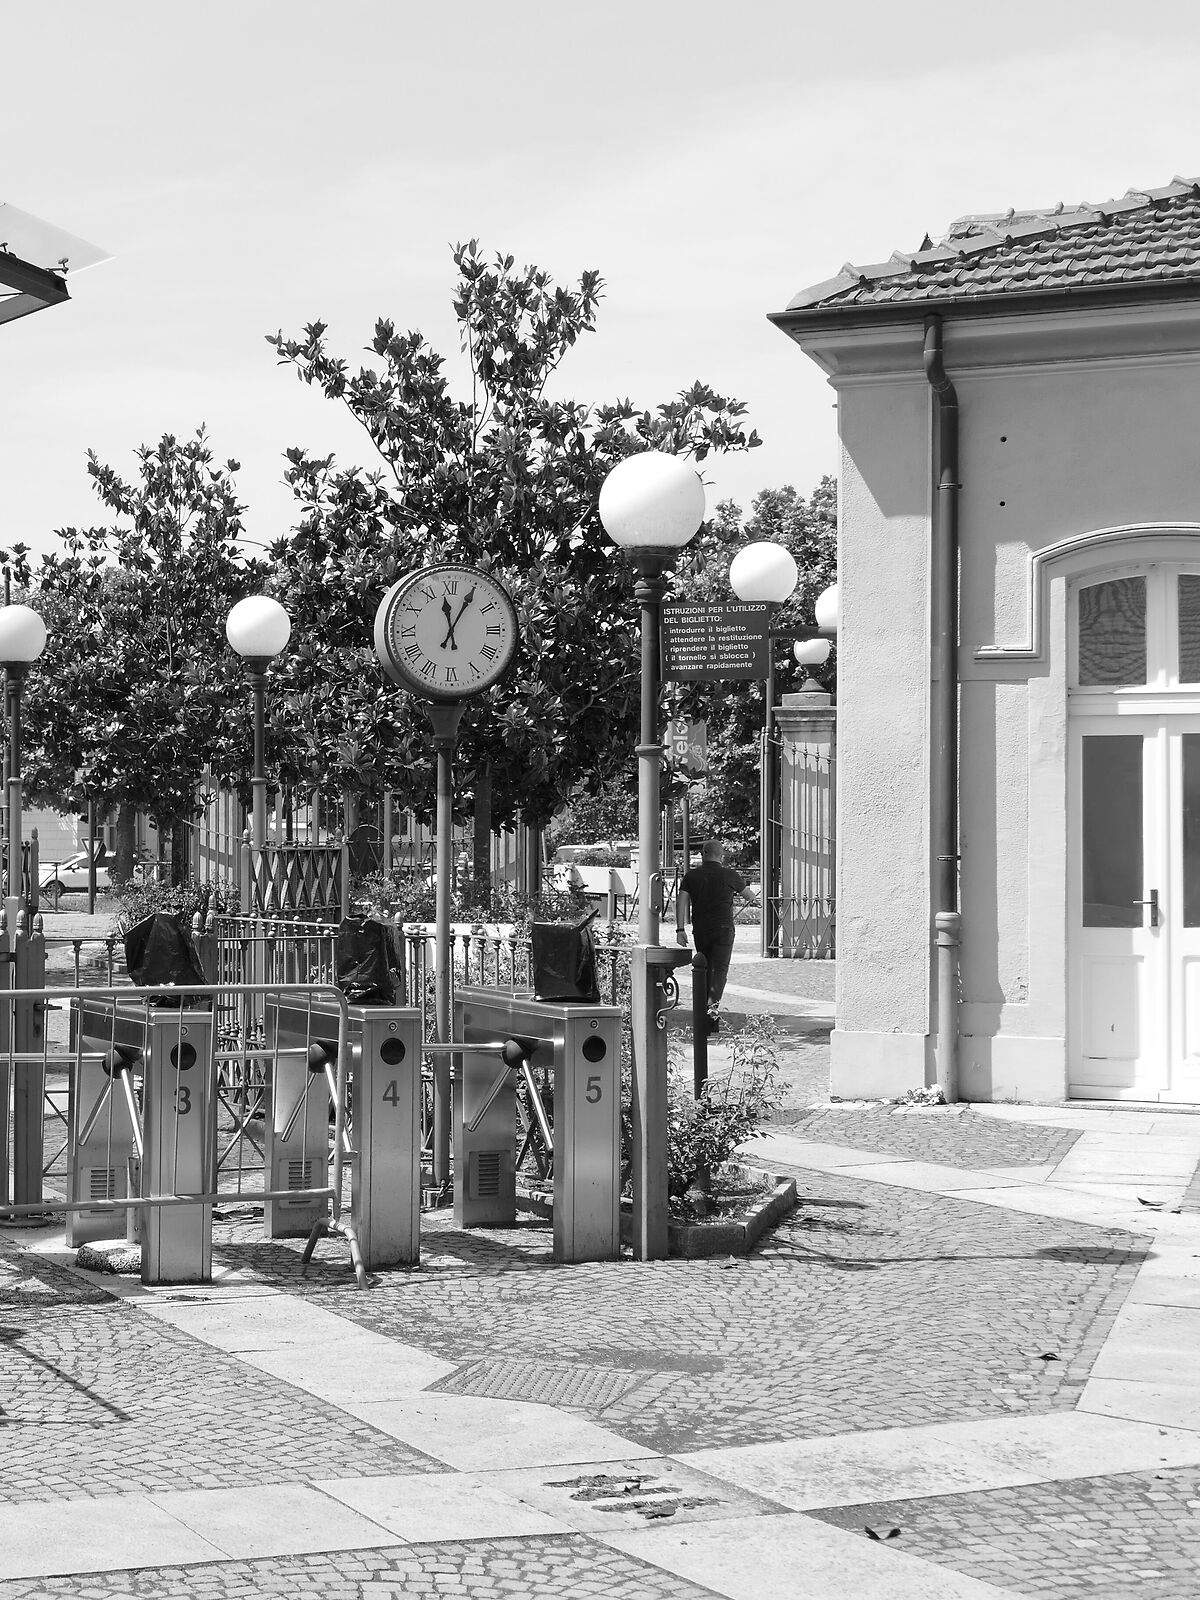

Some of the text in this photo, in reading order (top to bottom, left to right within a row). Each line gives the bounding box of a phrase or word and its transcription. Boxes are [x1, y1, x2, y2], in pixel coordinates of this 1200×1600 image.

[726, 604, 767, 613] L'UTILIZZO
[681, 615, 722, 623] BIGLIETTO:
[715, 625, 747, 634] biglietto
[718, 634, 763, 642] restituzione
[670, 645, 708, 653] riprendere
[718, 643, 749, 652] biglietto
[719, 652, 749, 660] sblocca
[706, 661, 753, 670] rapidamente
[382, 1079, 401, 1107] 4
[586, 1075, 603, 1104] 5
[171, 1085, 192, 1116] 3
